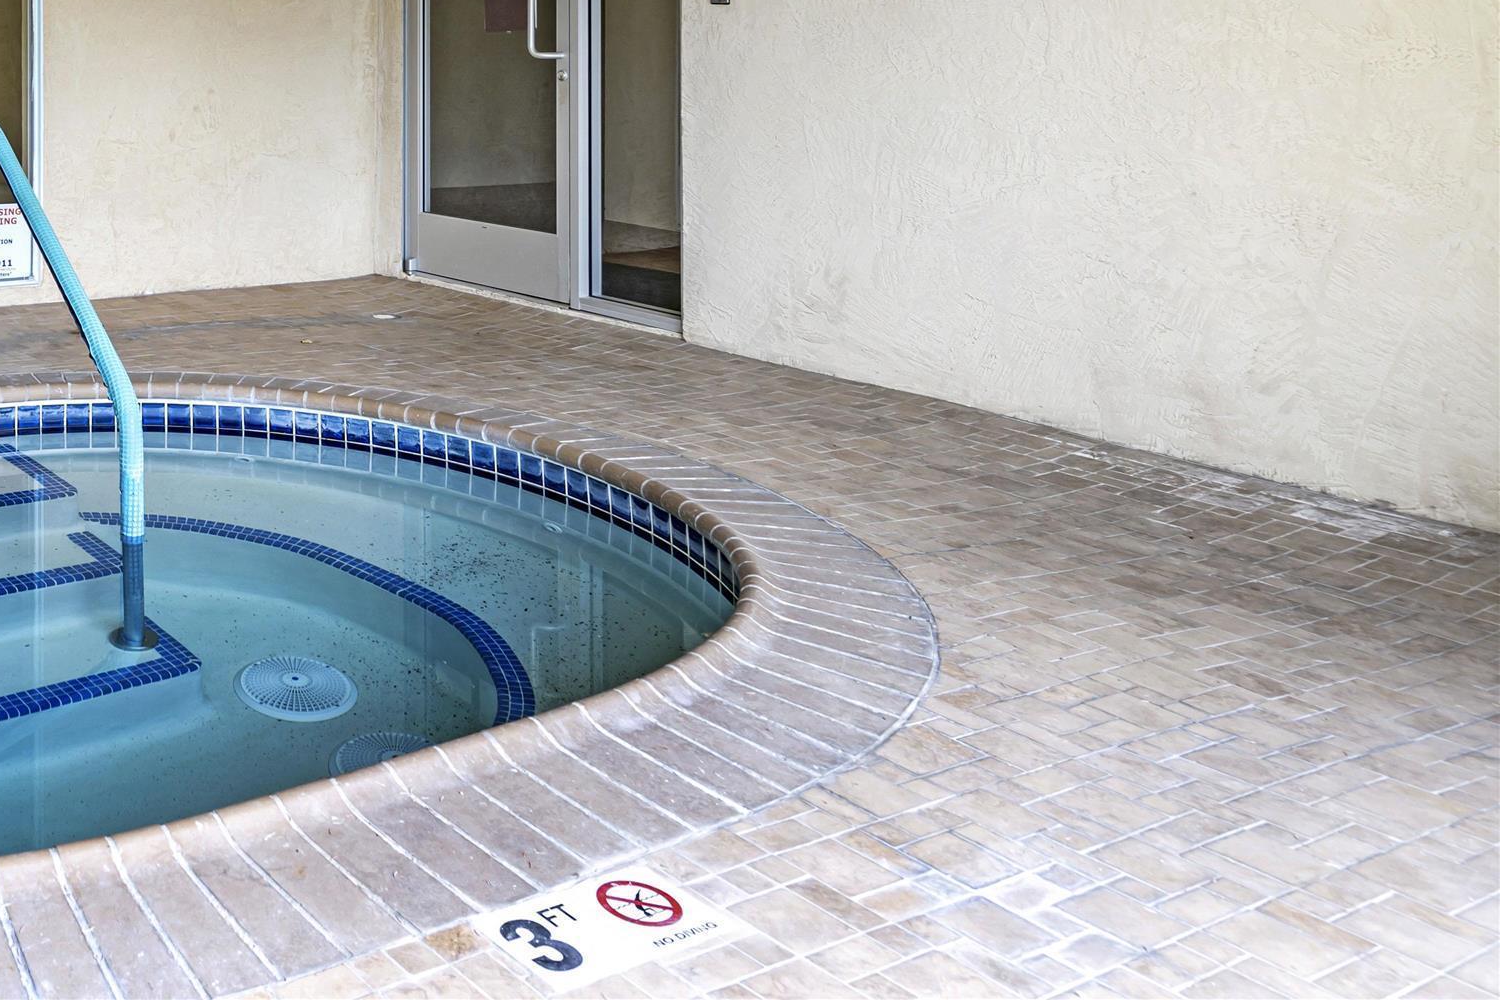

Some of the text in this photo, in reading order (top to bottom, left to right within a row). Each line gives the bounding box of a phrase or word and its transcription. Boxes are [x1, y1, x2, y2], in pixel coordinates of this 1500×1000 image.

[499, 903, 583, 972] 3 FT
[653, 921, 718, 947] NO DIVING
